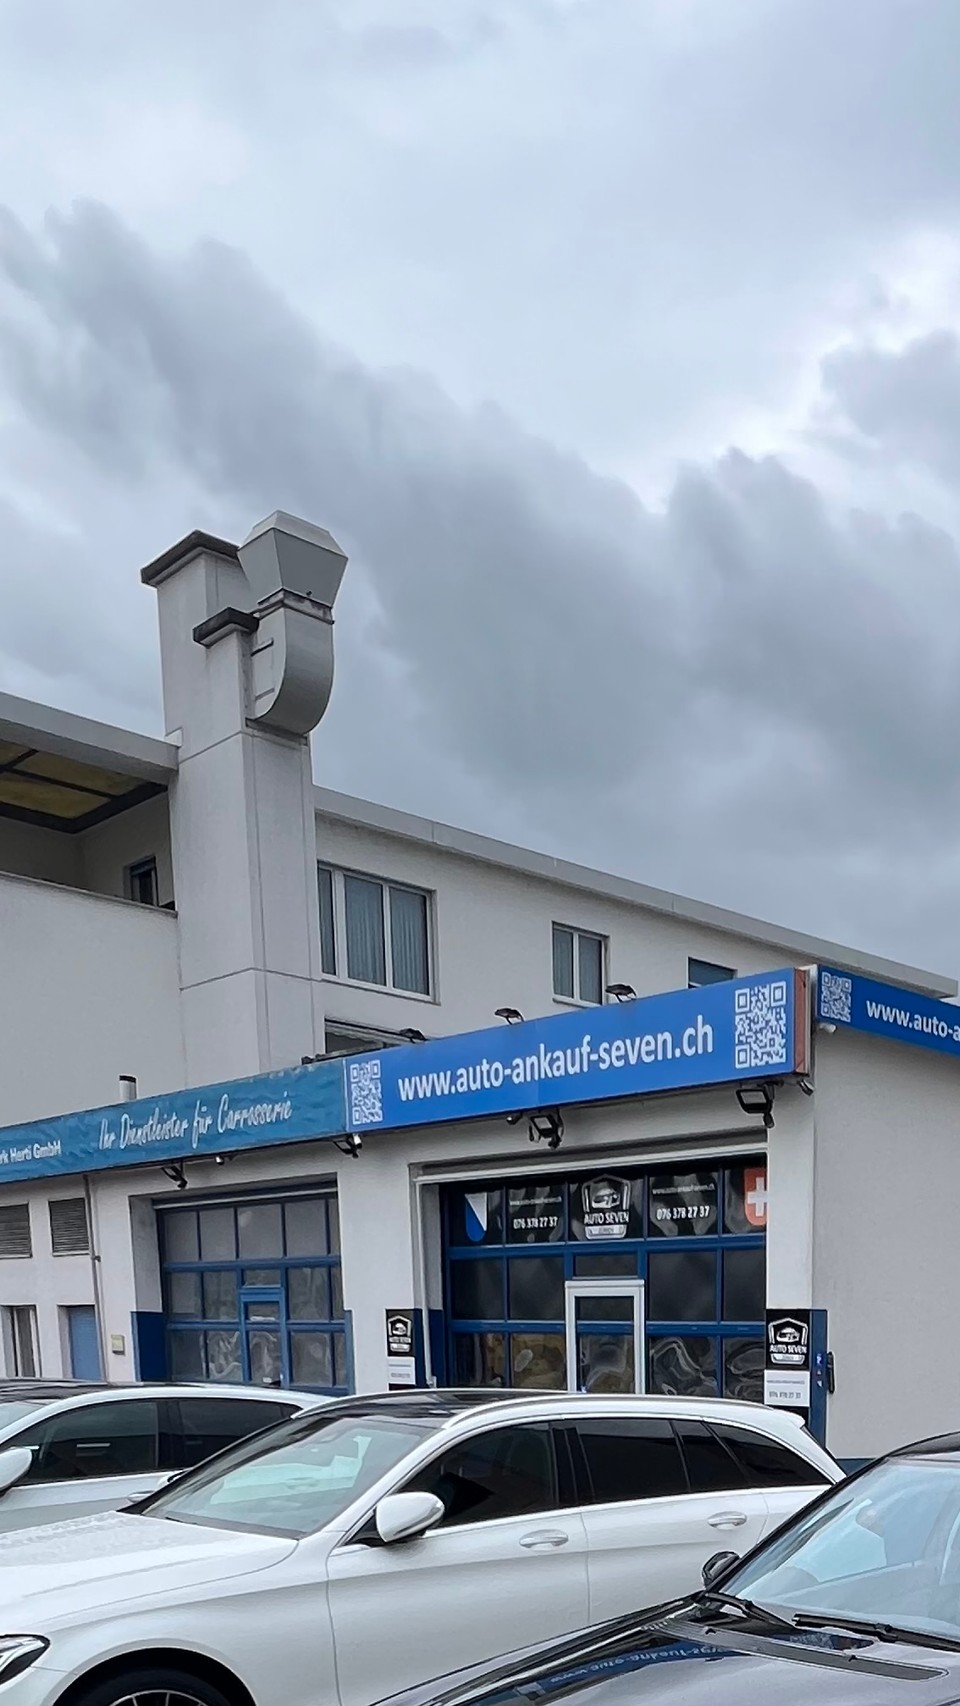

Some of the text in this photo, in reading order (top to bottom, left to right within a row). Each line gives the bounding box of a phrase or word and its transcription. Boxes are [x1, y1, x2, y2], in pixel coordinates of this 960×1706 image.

[397, 1014, 714, 1101] www.auto-ankauf-seven.ch
[100, 1091, 293, 1150] Ihr Dienstleister für Carrosserie
[33, 1139, 61, 1159] GmbH
[584, 1210, 629, 1225] AUTO SEVEN
[656, 1208, 672, 1220] 076
[687, 1205, 698, 1218] 27
[700, 1205, 710, 1217] 37
